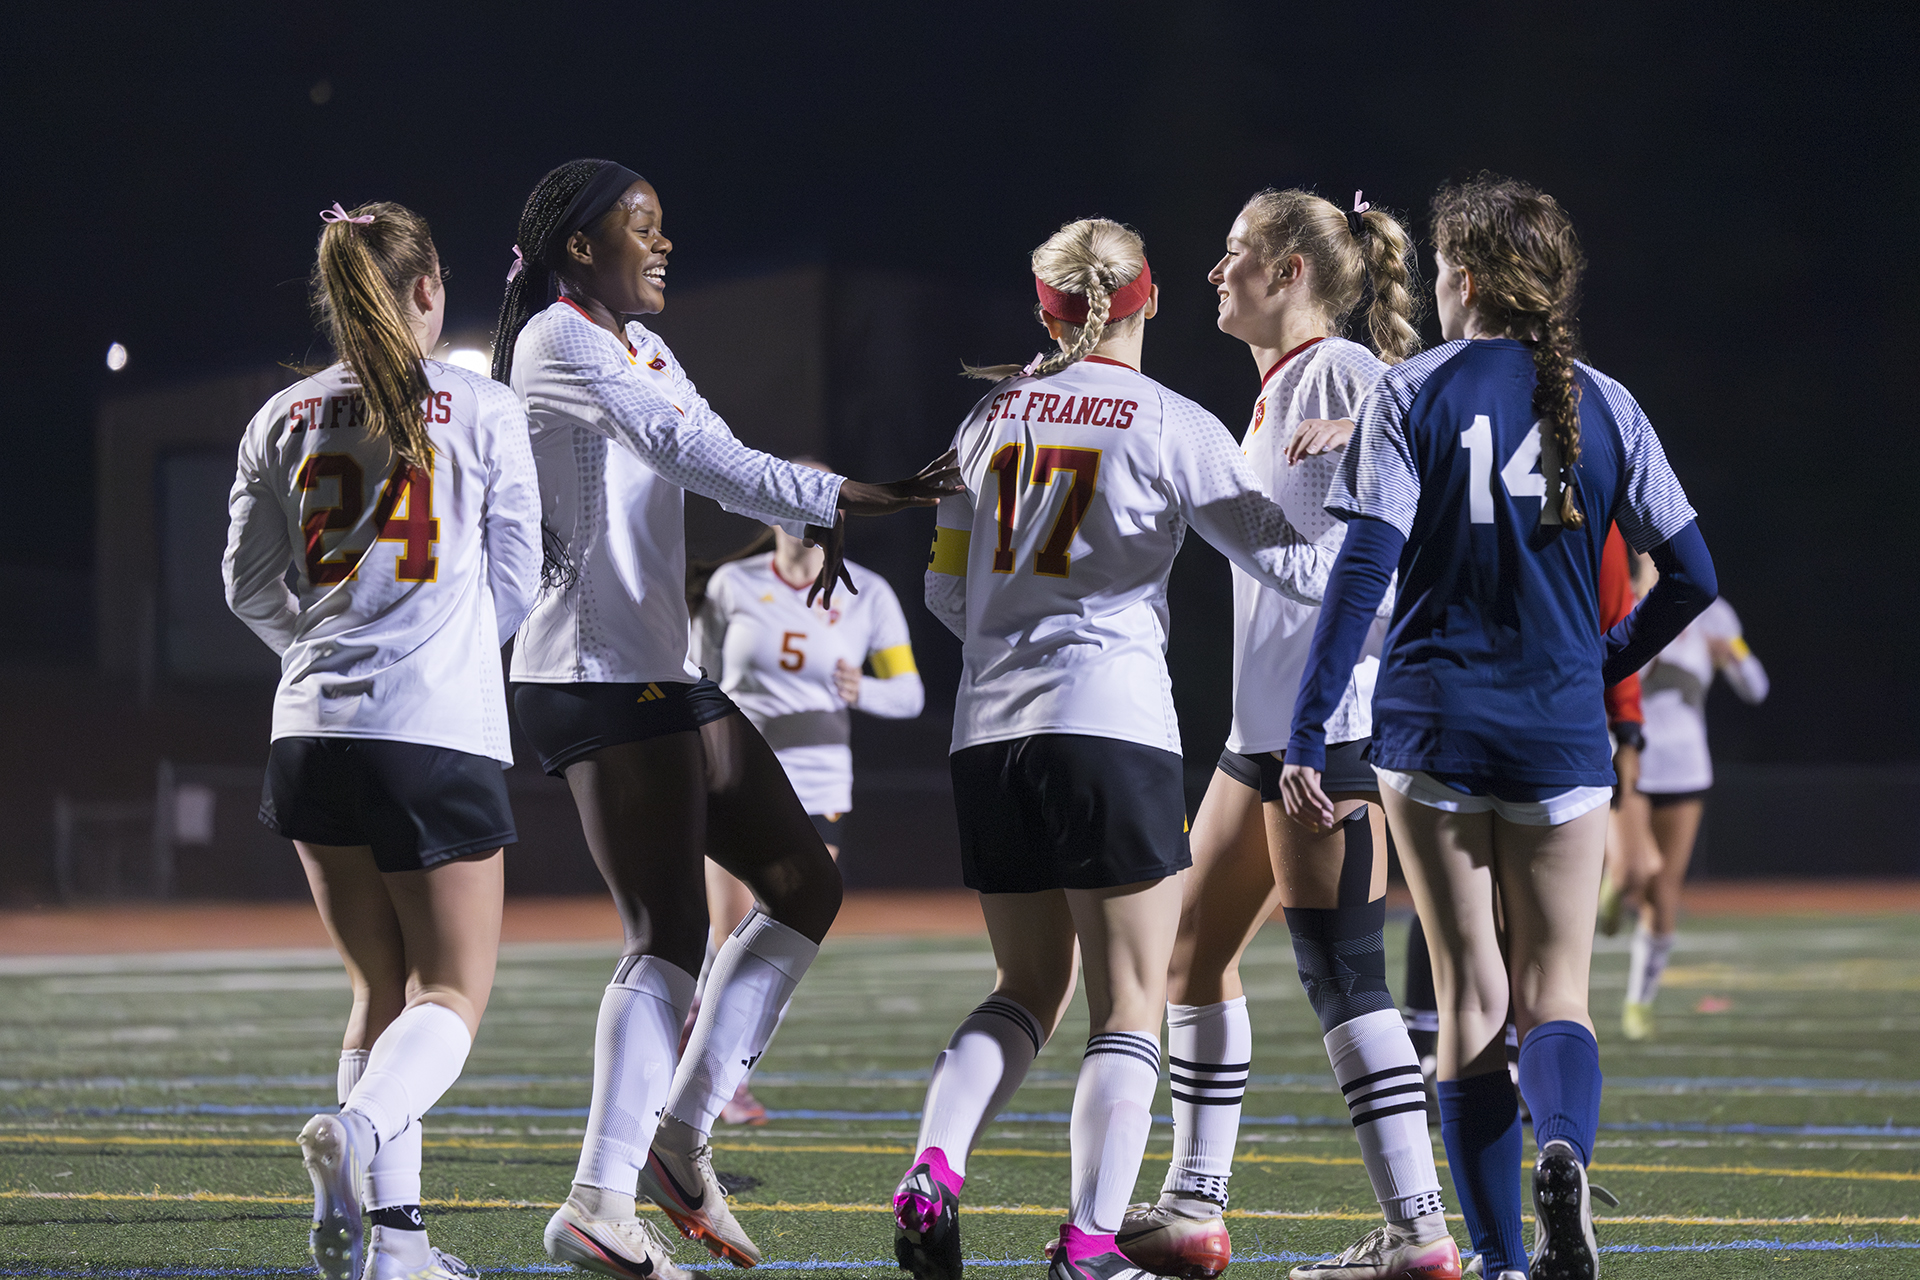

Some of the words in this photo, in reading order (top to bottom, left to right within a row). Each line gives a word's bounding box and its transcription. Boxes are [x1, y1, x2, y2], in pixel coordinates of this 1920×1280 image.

[289, 396, 325, 433] ST.
[986, 390, 1022, 422] ST.
[1022, 392, 1138, 430] FRANCIS
[1460, 414, 1567, 525] 14
[296, 447, 441, 587] 24
[990, 442, 1103, 578] 17
[779, 631, 808, 673] 5
